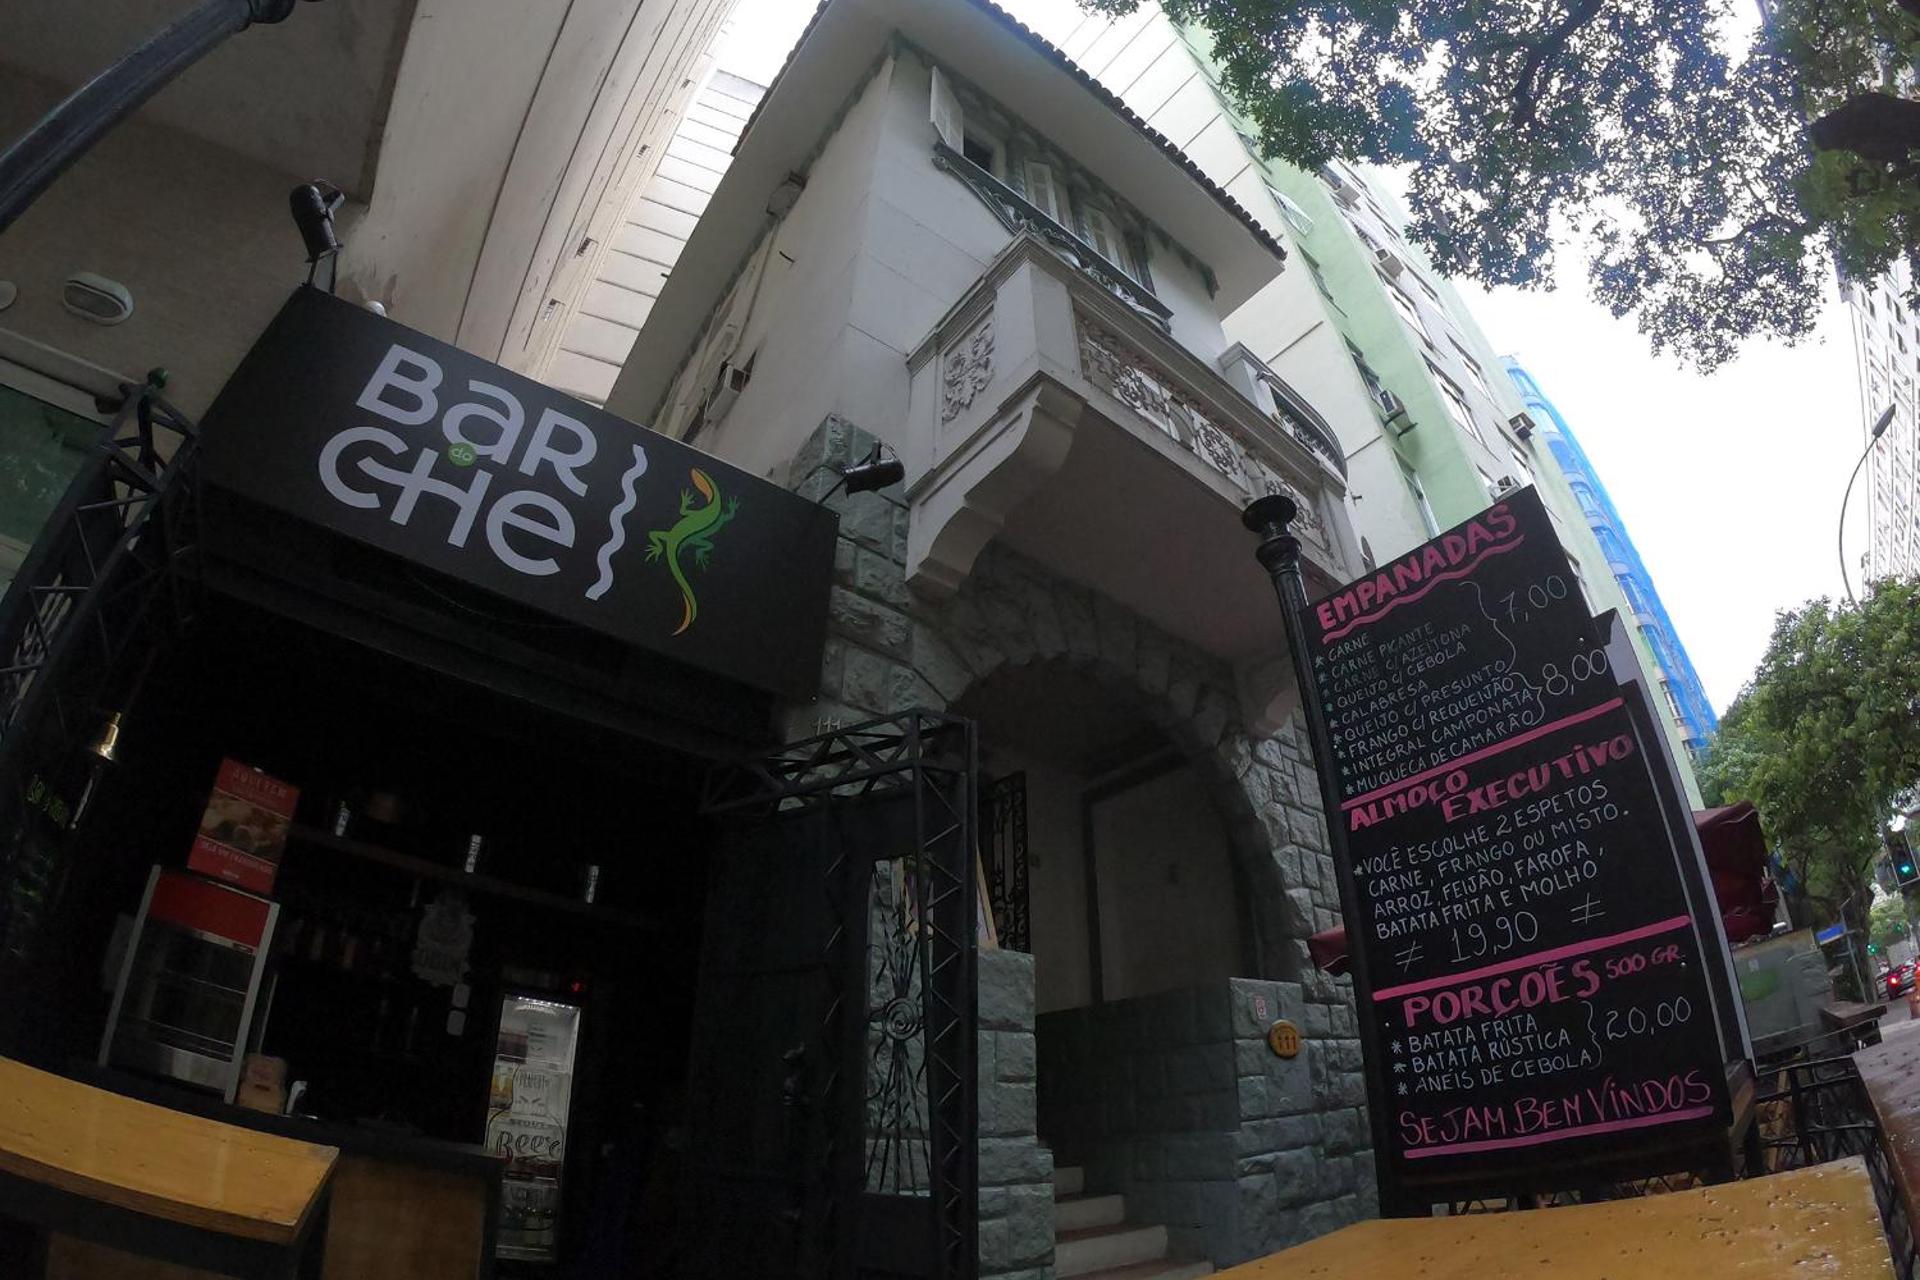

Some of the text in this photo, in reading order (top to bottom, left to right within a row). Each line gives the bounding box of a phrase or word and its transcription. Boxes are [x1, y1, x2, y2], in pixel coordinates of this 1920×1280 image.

[1316, 504, 1517, 630] EMPANADAS
[1500, 575, 1567, 622] 7,00
[1328, 633, 1370, 661] CARNE
[1332, 651, 1377, 678] CARNE
[1334, 667, 1379, 692] CARNE
[1337, 680, 1388, 708] QUEIJO
[1407, 641, 1467, 676] CEBOLA
[1542, 649, 1607, 696] 8,00
[1342, 680, 1428, 724] CALABRESA
[1345, 711, 1399, 742] QUEIJO
[1421, 660, 1506, 708] PRESUNTO
[1349, 724, 1409, 758] FRANGO
[1429, 676, 1514, 725] REQUEIJÃO
[1352, 688, 1534, 774] INTEGRAL CAMPONATA
[1356, 710, 1534, 793] MUQUECA DE CAMARÃO
[1350, 769, 1470, 832] ALMOÇO
[1362, 779, 1609, 874] VOCÊ ESCOLHE 2 ESPETOS
[1438, 840, 1514, 877] FRANGO
[1523, 830, 1545, 849] OU
[1376, 911, 1440, 940] BATATA
[1501, 890, 1513, 908] E
[1520, 860, 1598, 901] MOLHO
[1450, 911, 1538, 963] 19,90
[1606, 958, 1646, 979] 500
[1409, 1026, 1478, 1054] BATATA
[1606, 996, 1692, 1040] 20,00
[1412, 1028, 1571, 1073] BATATA RÚSTICA
[1415, 1049, 1592, 1094] ANÉIS DE CEBOLA
[1400, 1106, 1507, 1146] SEJAM
[1513, 1094, 1582, 1134] BEM
